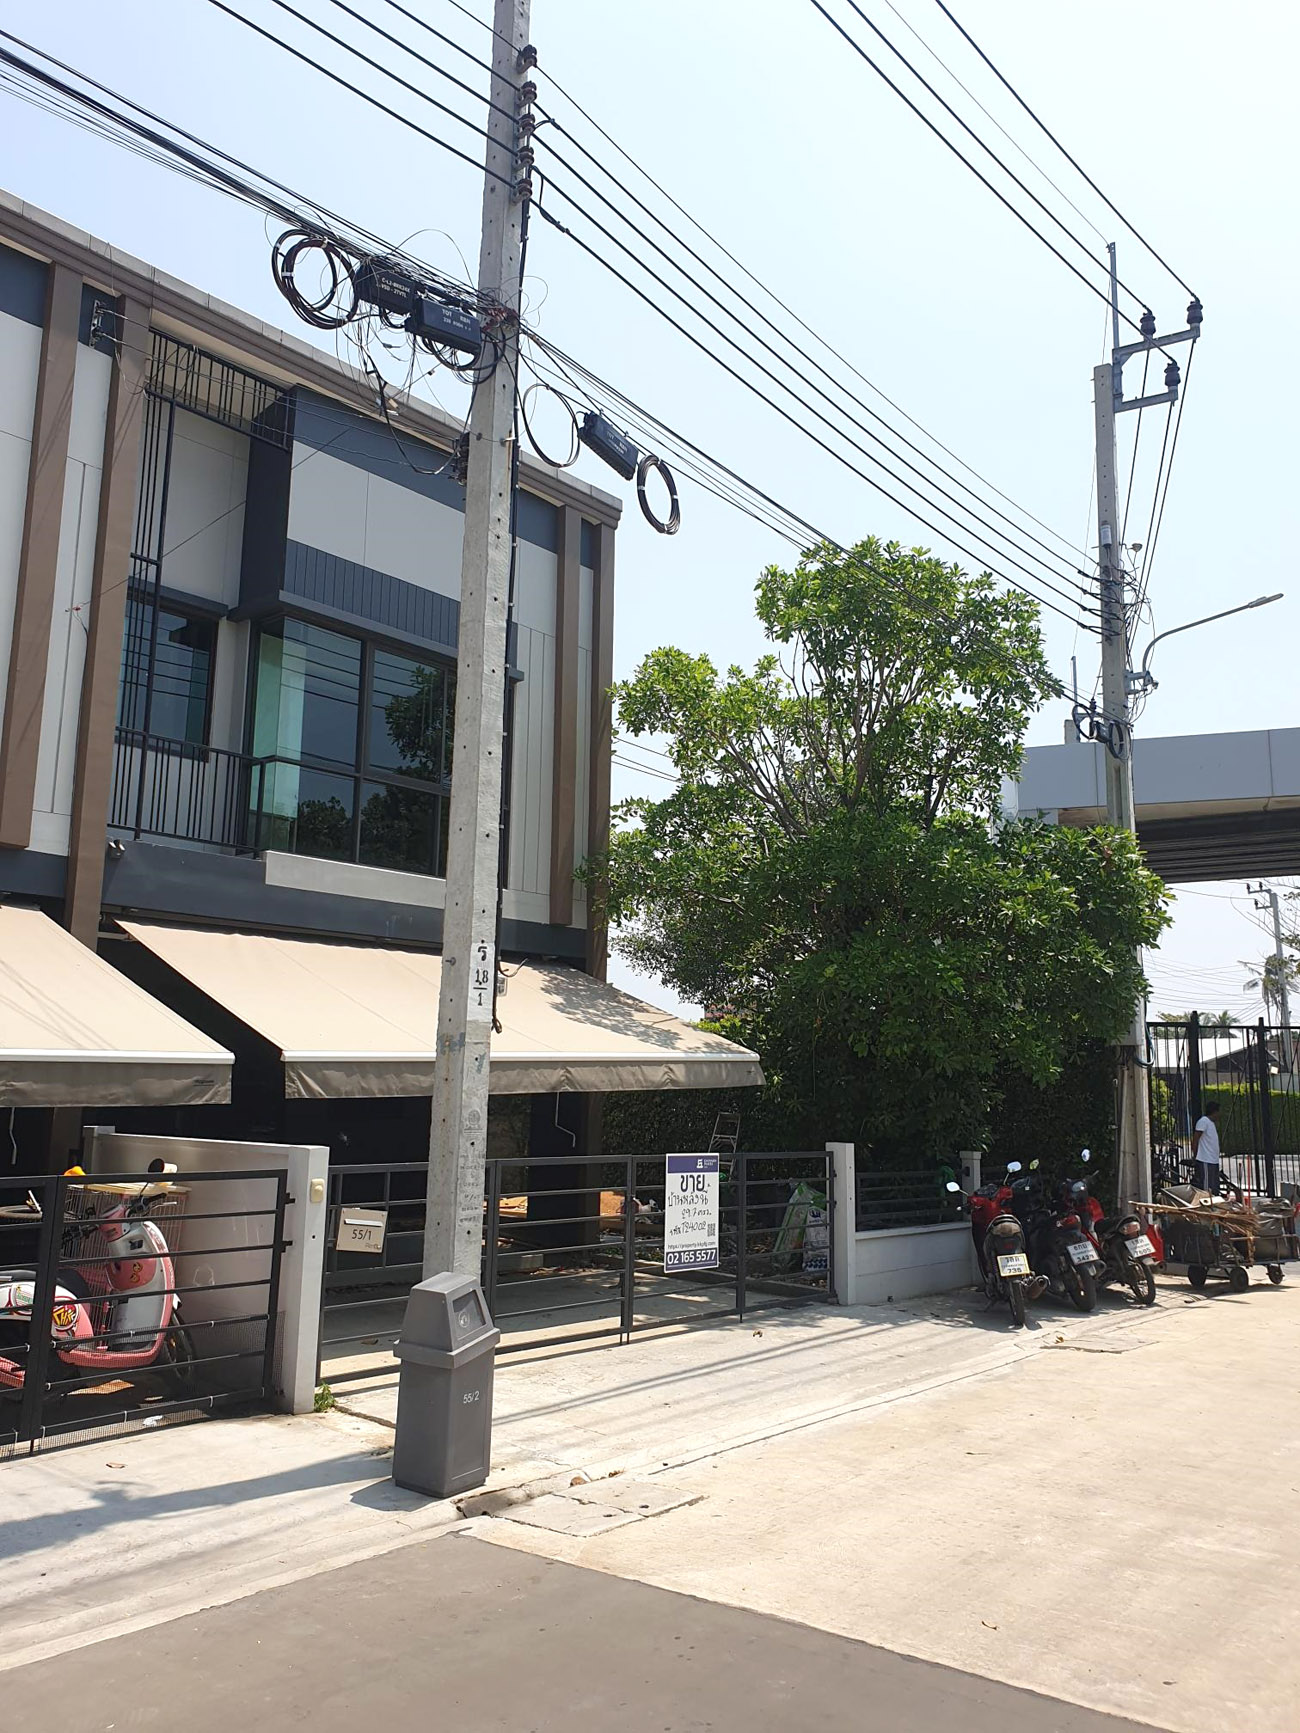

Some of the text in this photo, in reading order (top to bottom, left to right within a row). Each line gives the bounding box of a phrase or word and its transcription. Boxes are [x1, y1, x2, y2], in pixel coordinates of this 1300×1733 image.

[680, 1174, 706, 1193] ขาย
[351, 1229, 372, 1241] 55/1
[667, 1249, 716, 1265] 02 165 5577
[463, 1390, 480, 1404] 55/2
